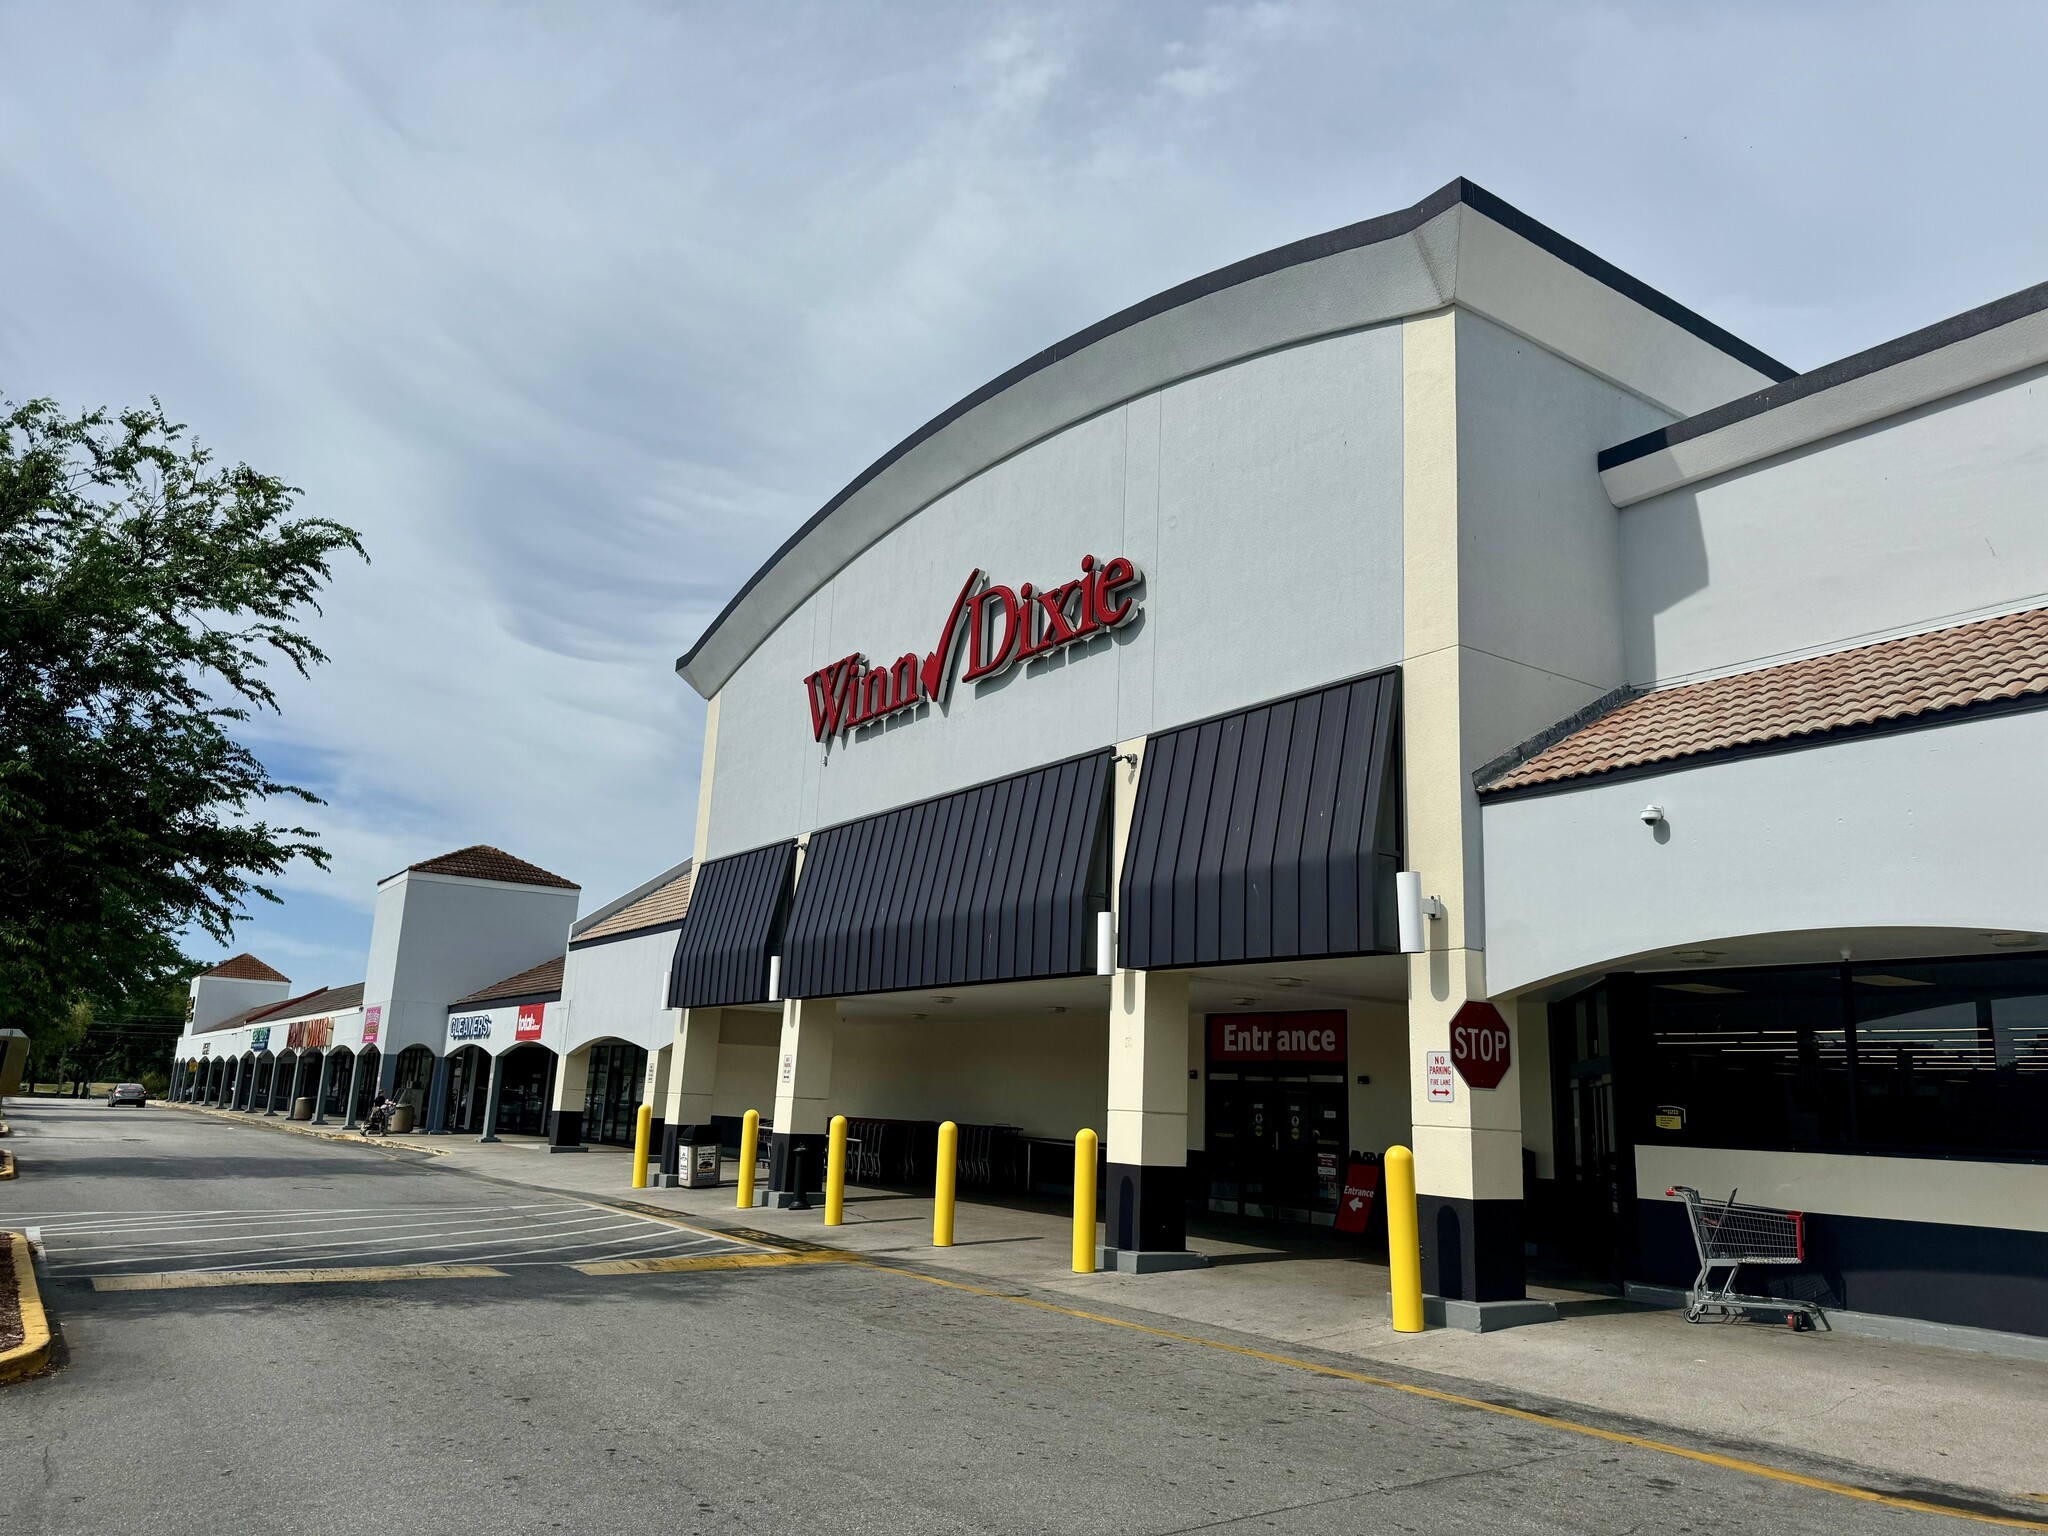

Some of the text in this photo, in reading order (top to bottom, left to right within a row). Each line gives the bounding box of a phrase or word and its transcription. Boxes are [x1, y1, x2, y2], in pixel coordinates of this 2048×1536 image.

[803, 554, 1137, 743] Winn Dixie
[450, 1014, 491, 1038] CLEANERS
[1224, 1024, 1336, 1052] Entrance
[1455, 1027, 1507, 1062] STOP
[1429, 1066, 1451, 1075] PARKING
[1434, 1056, 1445, 1065] NO
[1344, 1185, 1374, 1198] Entrance
